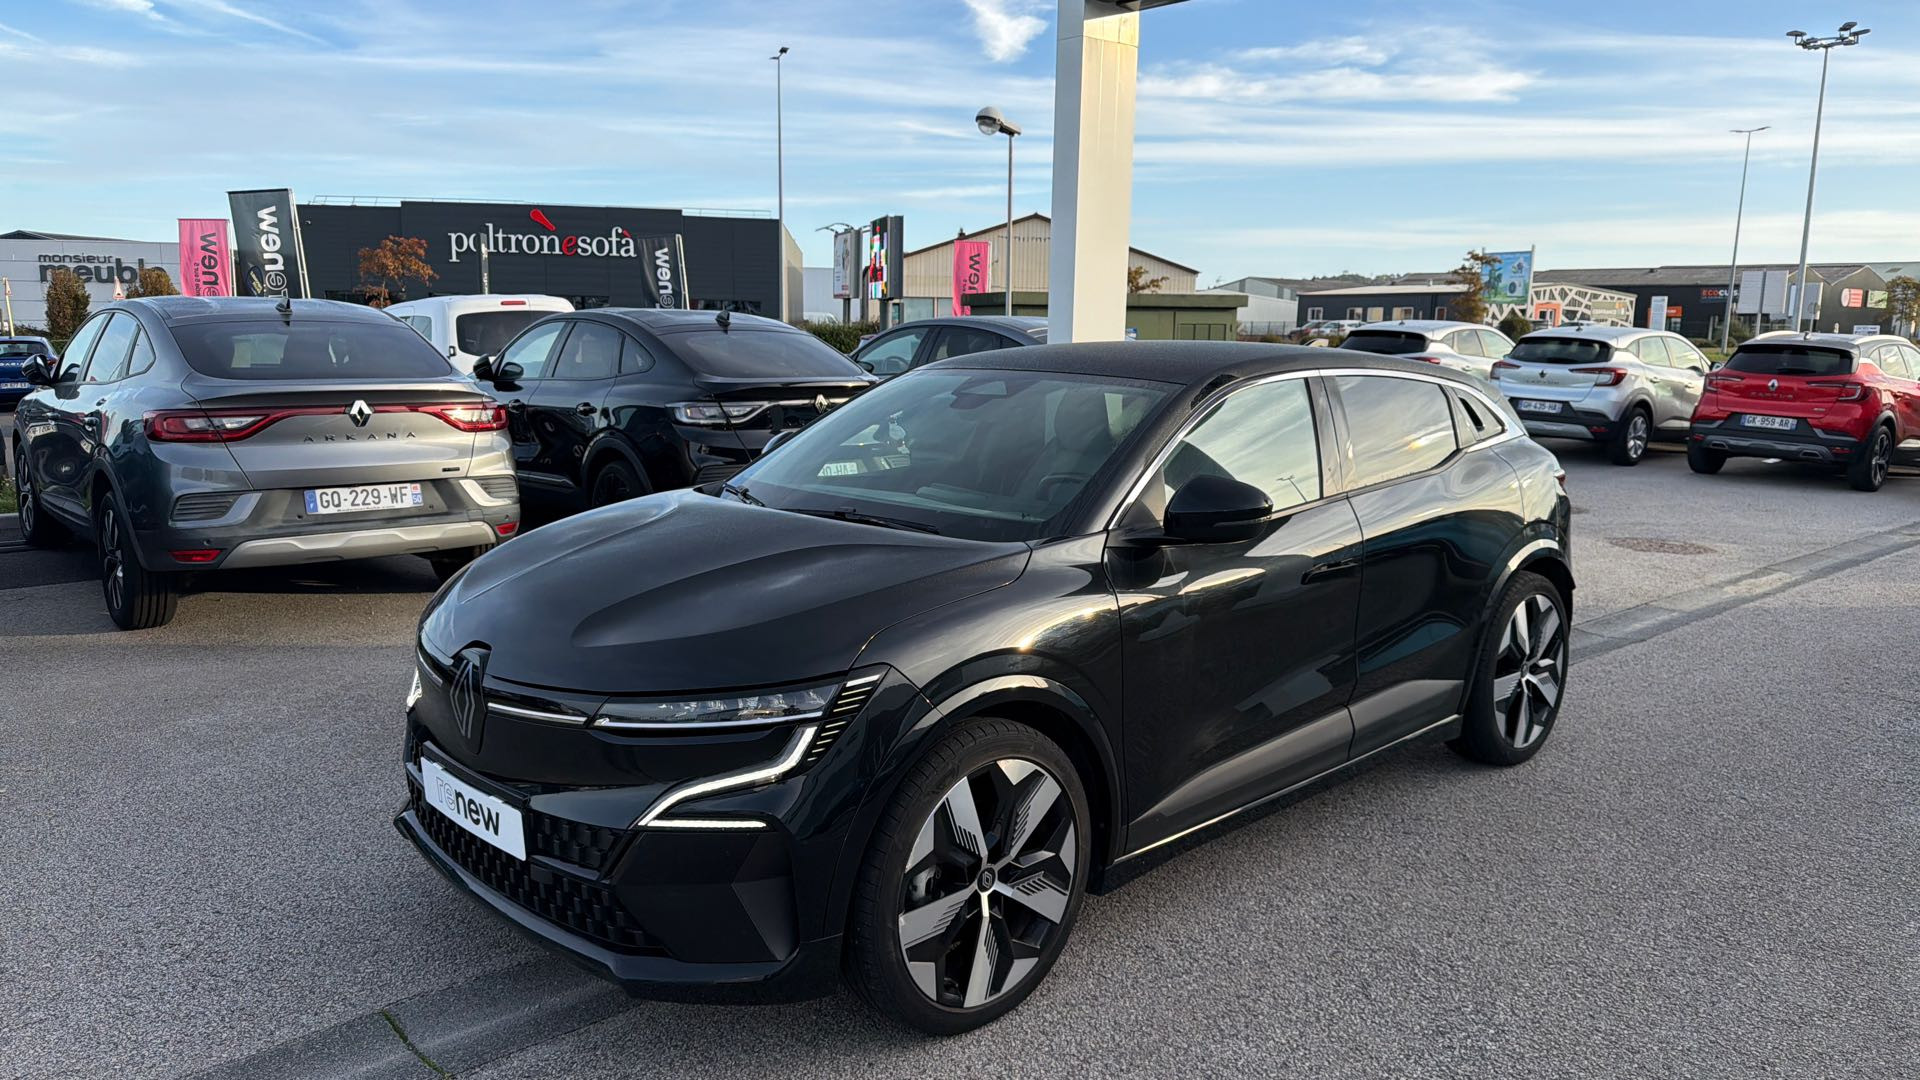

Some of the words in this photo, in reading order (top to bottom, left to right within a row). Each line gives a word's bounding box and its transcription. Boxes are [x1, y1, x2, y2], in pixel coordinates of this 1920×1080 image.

[38, 252, 113, 264] monsieur
[1747, 416, 1790, 428] GK-959-AR
[303, 431, 417, 443] ARKANA
[319, 486, 408, 509] GQ-229-WF
[435, 776, 500, 837] renew
